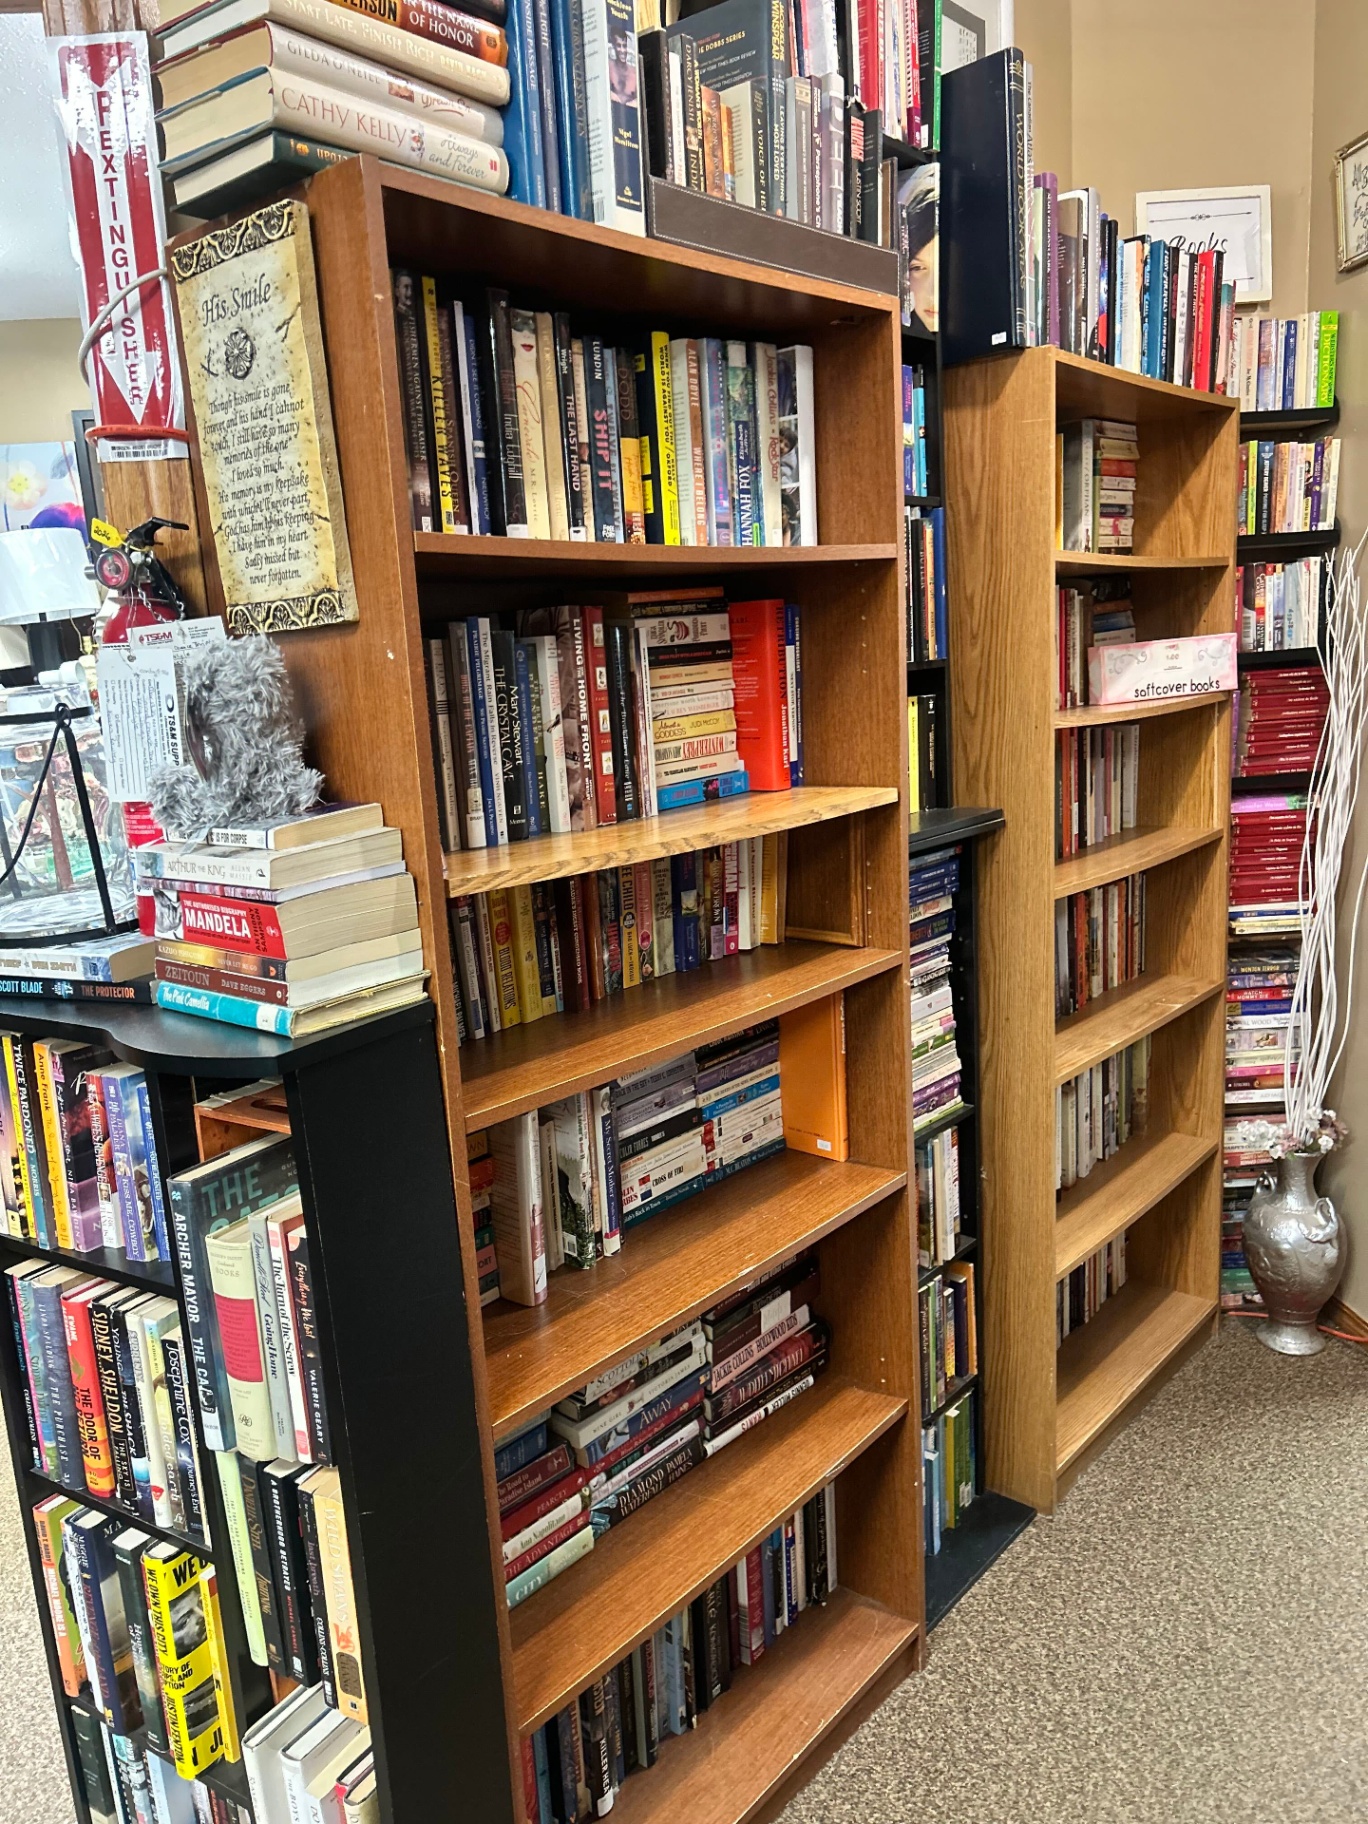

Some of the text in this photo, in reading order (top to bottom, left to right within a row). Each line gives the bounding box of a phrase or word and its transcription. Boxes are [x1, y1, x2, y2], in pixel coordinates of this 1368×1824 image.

[408, 10, 425, 27] OF
[427, 18, 475, 48] HONOR
[540, 14, 549, 49] LIGHT
[725, 30, 746, 45] SERIES
[771, 0, 781, 59] WINSPEAR
[286, 40, 330, 66] GILDA
[405, 39, 434, 63] RICH
[527, 39, 537, 91] PASSAGE
[685, 44, 695, 122] D'ARCY JENISH
[281, 87, 408, 149] CATHY KELLY
[440, 134, 479, 160] Always
[451, 154, 488, 180] Forever
[814, 148, 822, 212] Persephone's
[1168, 231, 1229, 254] Books
[100, 130, 143, 405] EXTINGUISHER
[202, 272, 271, 327] His Smile
[408, 317, 420, 368] FISHERMEN
[560, 348, 569, 374] Wright
[592, 340, 602, 380] LUNDIN
[689, 348, 699, 407] ALAN DOYLE
[1320, 333, 1330, 403] DICTIONARY
[413, 370, 423, 410] AGAINST
[431, 375, 446, 435] KILLER
[617, 366, 631, 421] DODD
[767, 388, 778, 425] Collins
[417, 430, 427, 461] KAISER
[503, 413, 518, 439] India
[445, 420, 460, 513] SPANISH QUEEN
[568, 420, 581, 492] LAST HAND
[593, 409, 612, 491] SHIP IT
[275, 470, 309, 492] keepsake
[437, 444, 452, 498] WAVES
[693, 447, 706, 526] WHERE BELONG
[285, 511, 315, 529] keeping
[738, 464, 752, 546] HANNAH FOX
[244, 549, 286, 570] Sadly missed
[249, 568, 302, 587] never forgotten.
[573, 618, 591, 770] LIVING HOME FRONT
[1134, 675, 1221, 699] softcover books
[168, 714, 178, 740] TS&M
[494, 665, 514, 783] THE CRYSTAL CAVE
[509, 685, 524, 766] Mary Stewart
[654, 727, 687, 741] GODDESS
[781, 703, 789, 747] Jonathan
[231, 834, 247, 845] CORPSE
[167, 857, 226, 879] ARTHUR KING
[220, 905, 247, 917] BIOGRAPHY
[569, 880, 577, 909] READER'S
[622, 881, 635, 911] CHILD
[184, 908, 252, 939] MANDELA
[248, 907, 262, 951] ANTHONY
[254, 908, 268, 953] SAMPSON
[158, 945, 177, 956] KAZUO
[1240, 966, 1261, 974] WONTON
[0, 980, 43, 994] SCOTT BLADE
[81, 985, 135, 999] THE PROTECTOR
[165, 965, 210, 986] ZEITOUN
[221, 979, 266, 996] DAVE EGGERS
[498, 947, 517, 1011] BLOOD RELATIONS
[184, 992, 210, 1011] Camellia
[38, 1053, 51, 1111] Anne Frank
[13, 1044, 26, 1083] TWICE
[20, 1086, 36, 1153] PARDONED
[30, 1164, 40, 1197] MORRIS
[111, 1112, 121, 1150] PALMER
[94, 1143, 107, 1182] REVENGE
[603, 1120, 615, 1198] My Secret Mother
[201, 1162, 263, 1217] THE
[652, 1172, 667, 1188] CROSS
[70, 1198, 81, 1238] BAWDEN
[128, 1220, 140, 1257] COWBOY
[174, 1212, 207, 1363] ARCHER MAYOR THE
[294, 1261, 310, 1306] Everything
[263, 1313, 280, 1380] Going Home
[283, 1342, 296, 1377] Screw
[712, 1327, 786, 1388] JACKIE COLLINS HOLLYWOOD
[92, 1310, 123, 1433] SIDNEY SHELDON
[112, 1327, 124, 1372] YOUNG
[124, 1411, 137, 1457] SHACK
[165, 1343, 191, 1446] Josephine Cox
[309, 1369, 324, 1444] VALERIE GEARY
[639, 1394, 673, 1429] AWAY
[80, 1388, 97, 1443] THE DOOR
[54, 1410, 68, 1462] PURCHASE
[618, 1448, 692, 1508] DIAMOND PAMELA
[668, 1460, 694, 1484] HAINES
[242, 1473, 257, 1520] DANIELLE
[536, 1488, 568, 1514] PEARCEY
[271, 1488, 291, 1592] BROTHERHOOD BETRAYED
[525, 1525, 575, 1565] ADVANTAGE
[532, 1513, 566, 1540] Napolitano
[172, 1558, 198, 1589] WE
[323, 1506, 349, 1623] WILD SWANS
[515, 1575, 544, 1601] CITY
[157, 1632, 168, 1656] CITY
[171, 1726, 185, 1764] FENTON
[599, 1737, 609, 1775] KILLER
